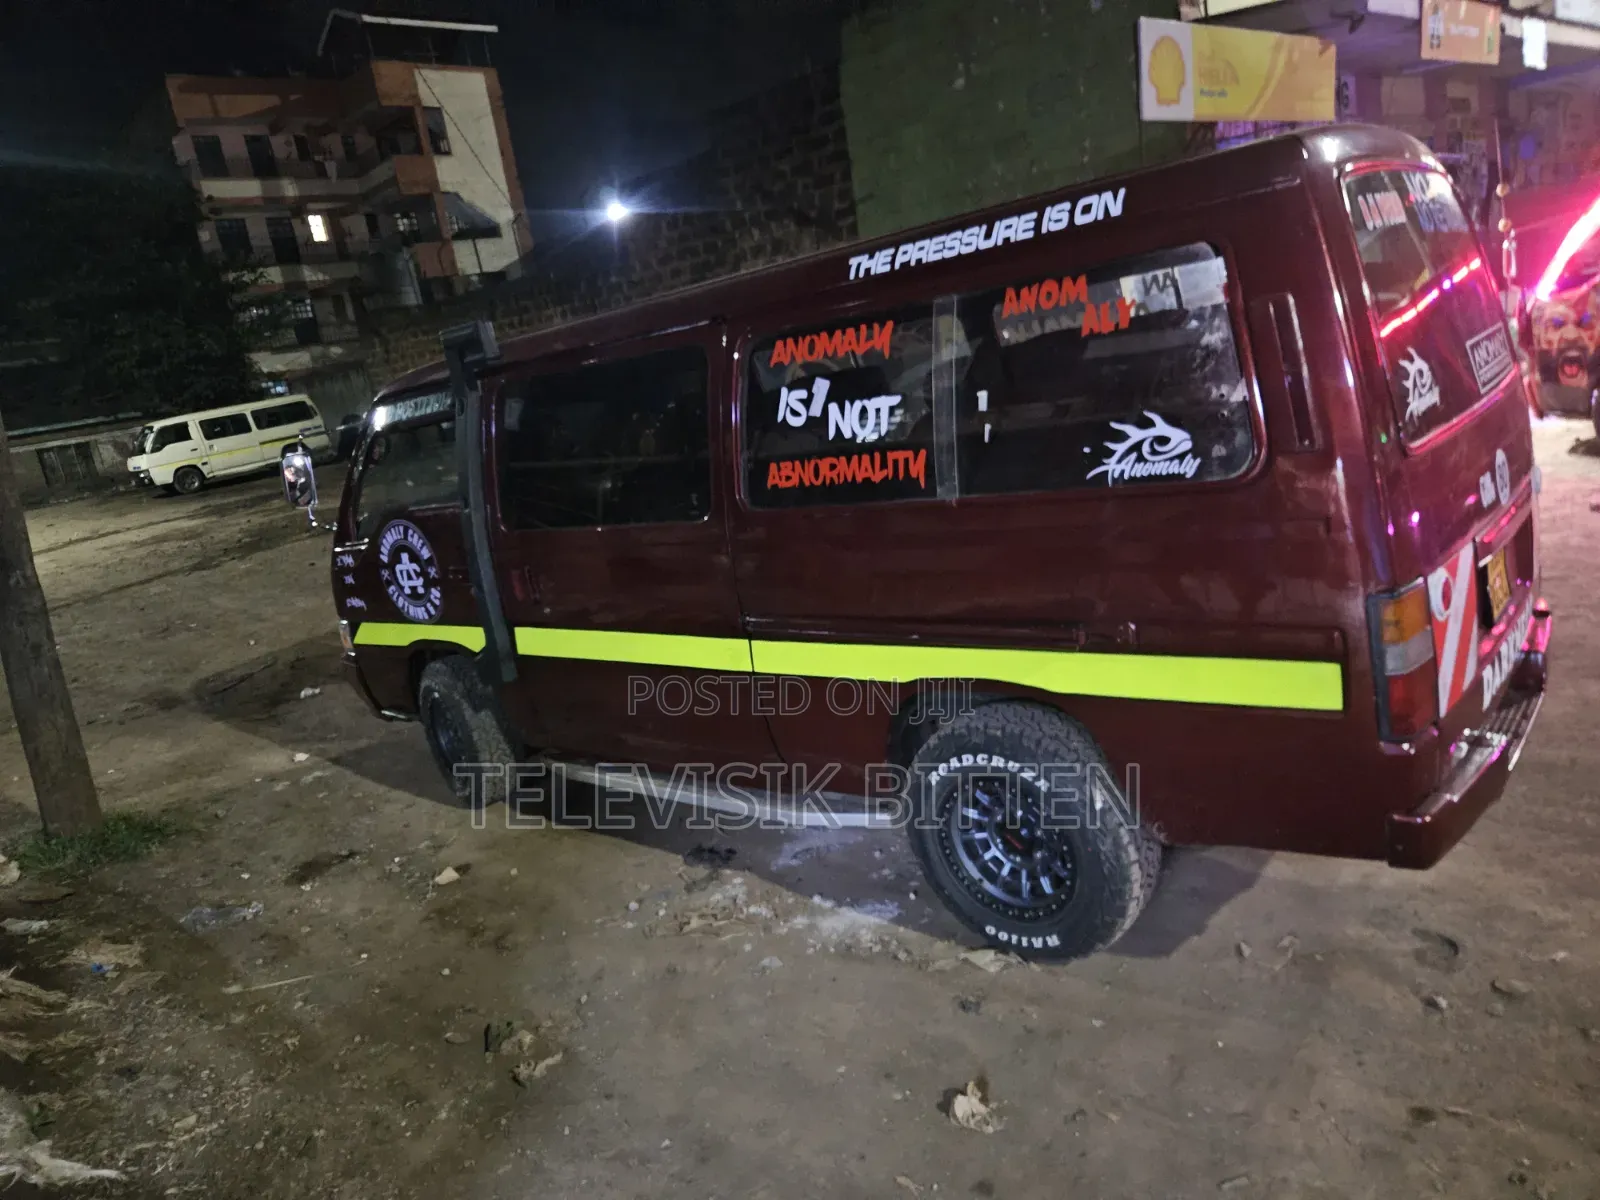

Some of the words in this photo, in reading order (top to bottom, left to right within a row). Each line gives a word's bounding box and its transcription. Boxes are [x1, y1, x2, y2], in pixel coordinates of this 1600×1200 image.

[848, 248, 895, 281] THE
[894, 211, 1038, 271] PRESSURE
[1041, 201, 1072, 234] IS
[1074, 187, 1127, 226] ON
[1002, 274, 1088, 320] ANOM
[1081, 296, 1136, 338] ALY
[769, 320, 894, 368] ANOMALY
[828, 394, 902, 441] NOT
[767, 448, 927, 490] ABNORMALITY
[1086, 452, 1202, 485] Anomaly
[928, 753, 1050, 793] ROADCRUZA
